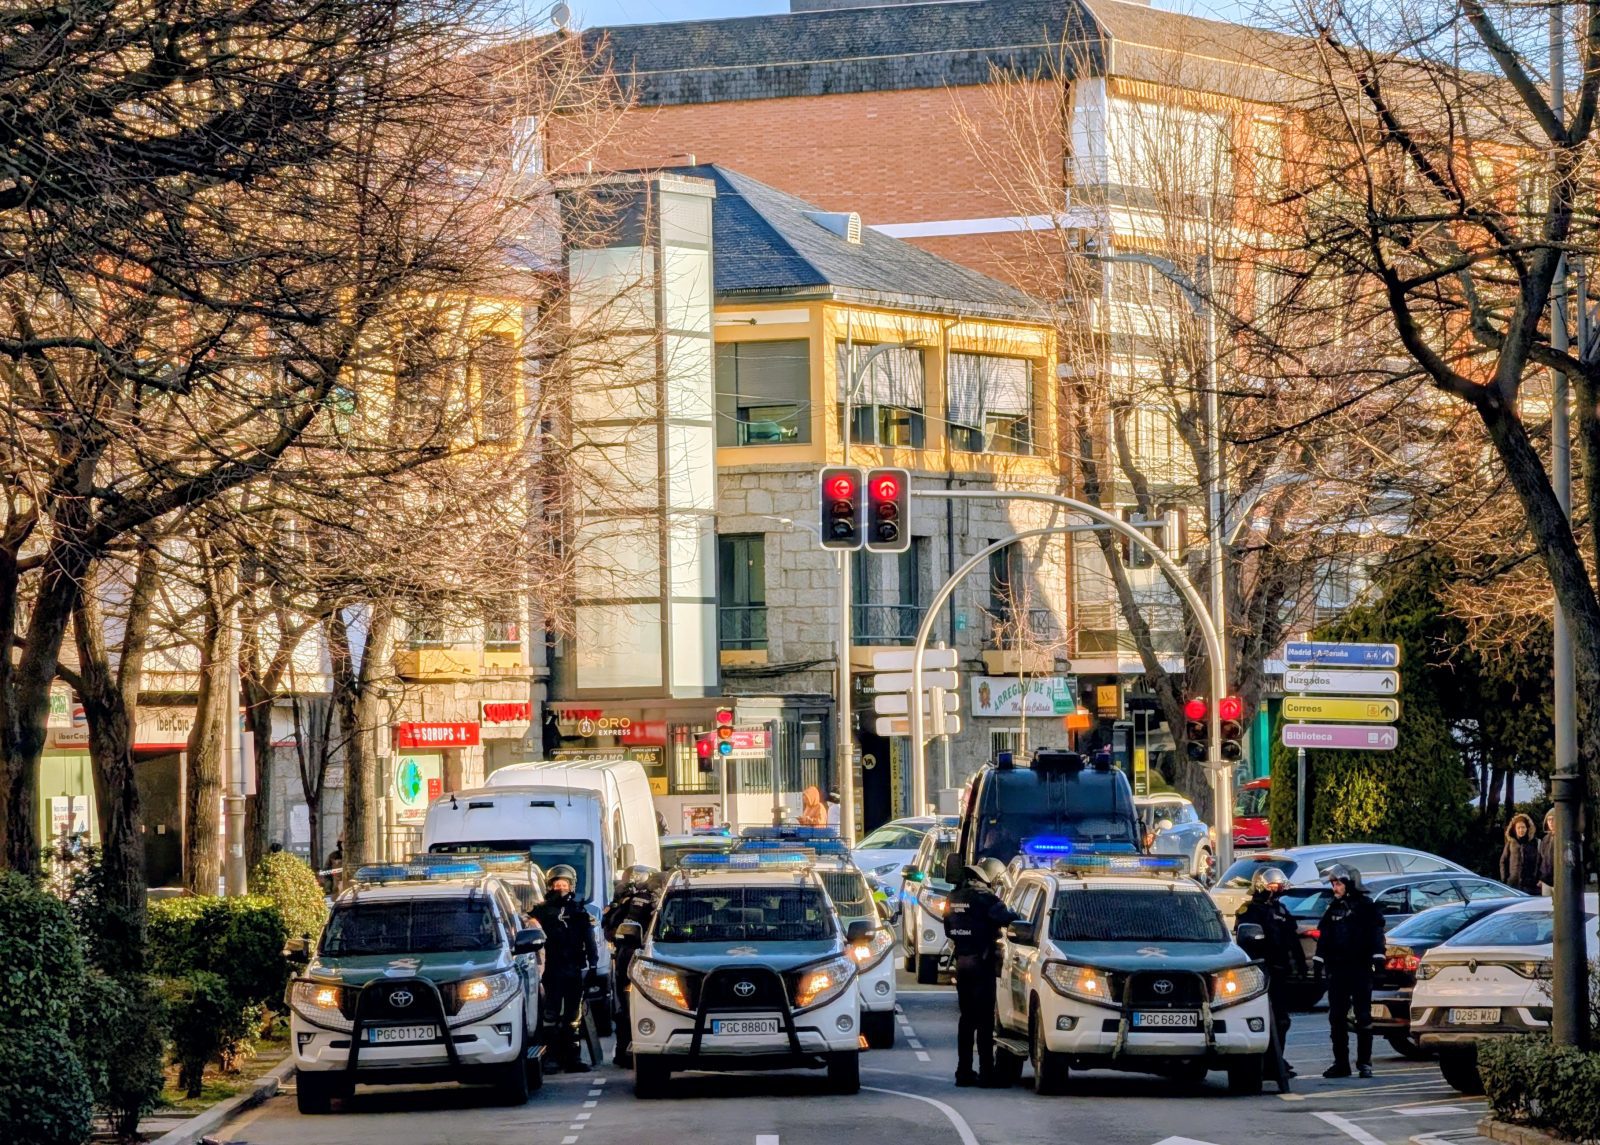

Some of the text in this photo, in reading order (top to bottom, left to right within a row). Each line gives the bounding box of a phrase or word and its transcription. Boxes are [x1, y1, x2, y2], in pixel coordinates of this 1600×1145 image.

[1288, 648, 1311, 656] Madrid
[1288, 676, 1330, 686] Juzgados
[1034, 681, 1044, 695] DE
[1287, 703, 1322, 713] Correos
[598, 717, 631, 729] ORO
[421, 727, 454, 742] SQRUPS
[598, 728, 631, 736] EXPRESS
[1286, 731, 1333, 741] Biblioteca
[1455, 1010, 1478, 1021] 0295
